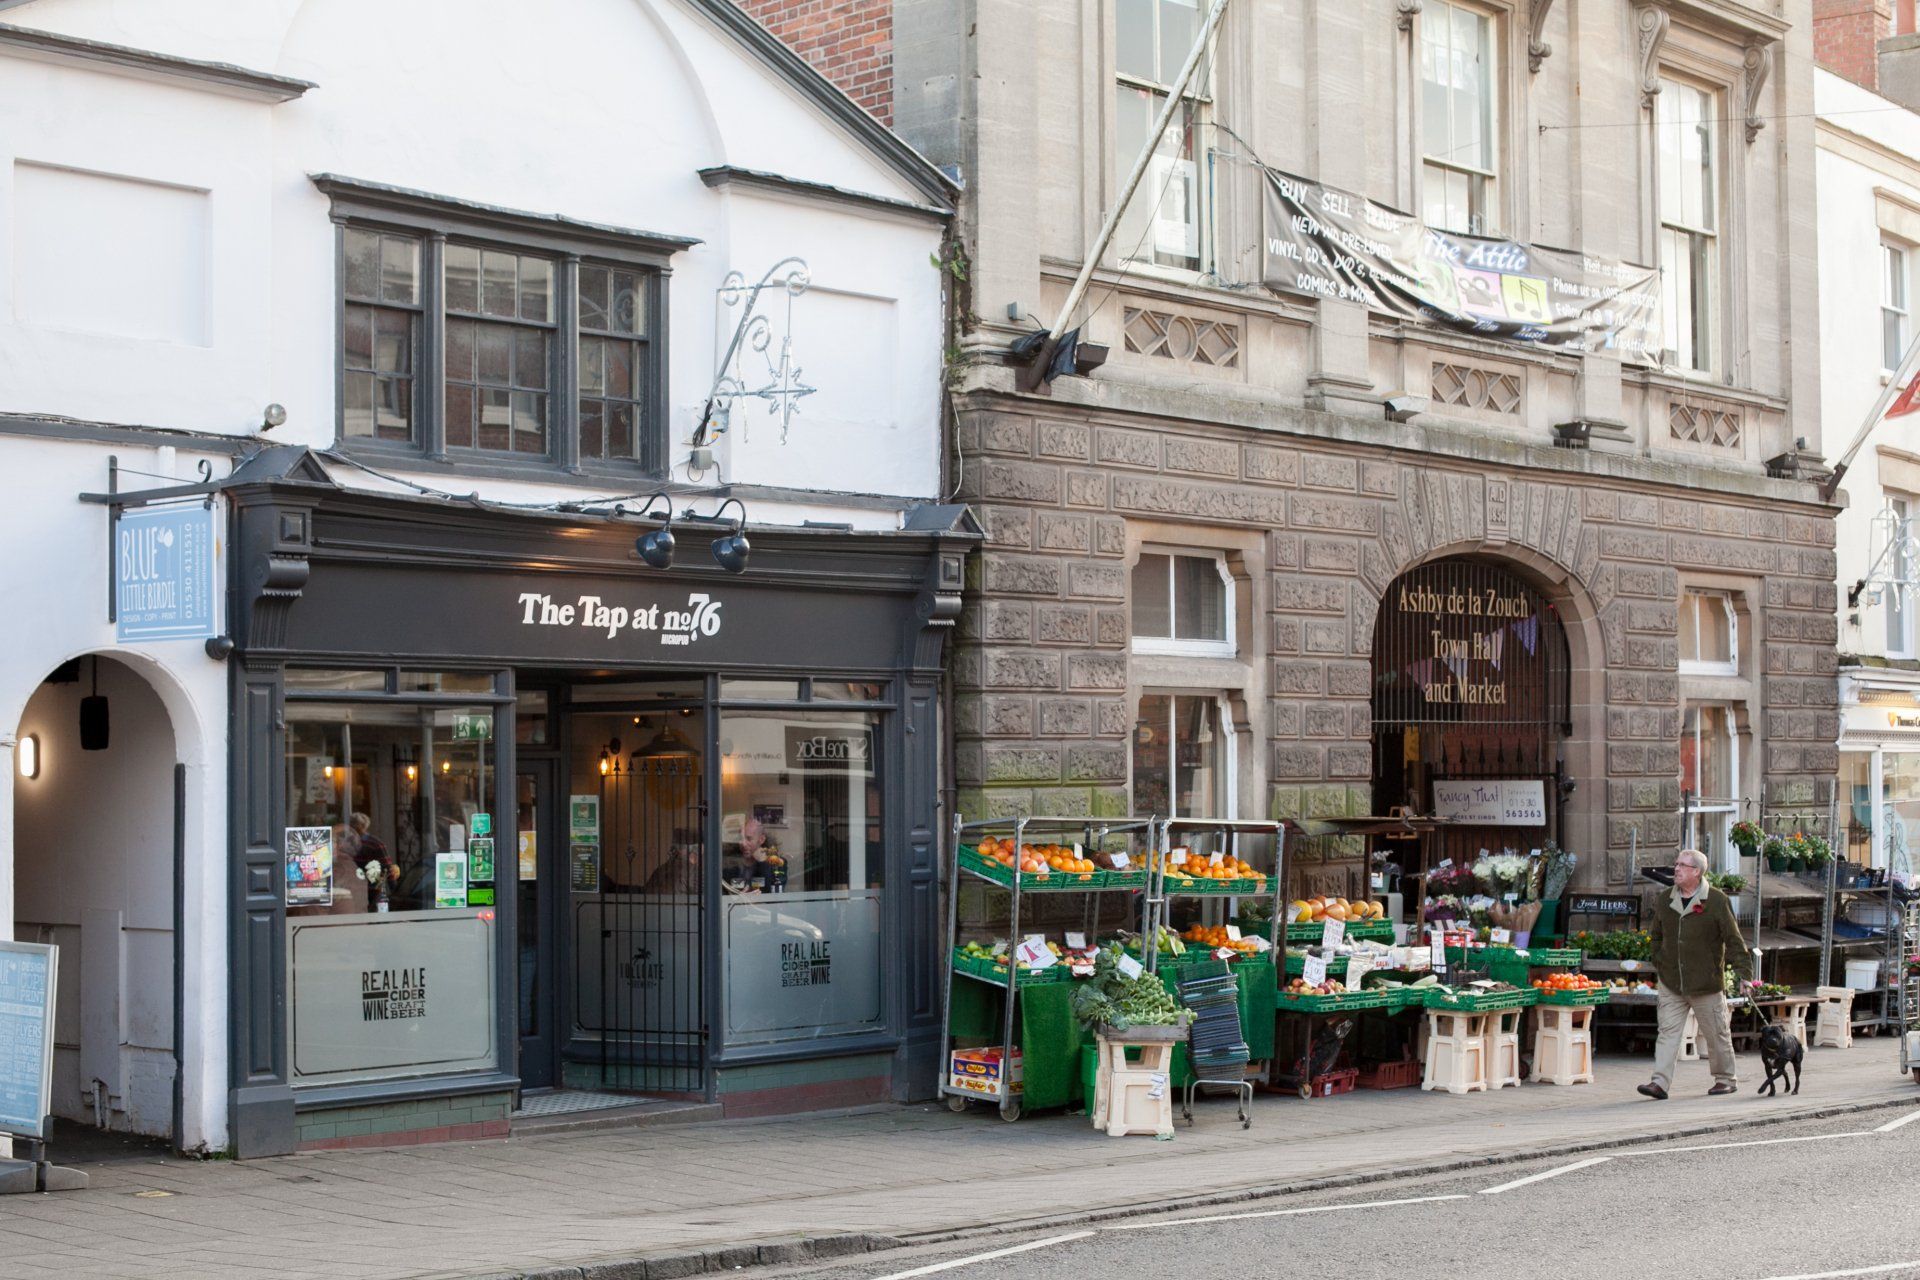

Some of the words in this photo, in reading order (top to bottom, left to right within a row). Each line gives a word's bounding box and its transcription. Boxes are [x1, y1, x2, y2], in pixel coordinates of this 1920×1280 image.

[1279, 178, 1308, 204] BUY
[1322, 192, 1352, 218] SELL
[1292, 214, 1319, 236] NEW
[1342, 231, 1393, 261] PRE-LOVED
[1424, 234, 1460, 260] The
[1465, 244, 1528, 271] Attic
[1297, 273, 1337, 296] COMICS
[1338, 285, 1348, 298] &
[1553, 277, 1578, 295] Phone
[1580, 285, 1590, 297] us
[122, 526, 159, 582] BLUE
[122, 583, 146, 612] LITTLE
[147, 581, 176, 610] BIRDIE
[1400, 584, 1443, 621] Ashby
[1447, 586, 1465, 614] de
[1468, 587, 1482, 616] la
[1486, 588, 1529, 618] Zouch
[518, 592, 576, 626] The
[578, 595, 629, 640] Tap
[631, 603, 658, 630] at
[1431, 630, 1468, 660] Town
[1473, 632, 1502, 661] Hall
[1425, 675, 1451, 703] and
[1457, 676, 1506, 704] Market
[1505, 809, 1542, 818] 563563
[781, 942, 806, 961] REAL
[810, 941, 831, 959] ALE
[21, 961, 45, 973] DESIGN
[781, 960, 810, 971] CIDER
[810, 966, 831, 985] WINE
[362, 969, 399, 992] REAL
[402, 968, 426, 989] ALE
[781, 977, 810, 987] BEER
[20, 990, 44, 1004] PRINT
[389, 988, 425, 1002] CIDER
[389, 1000, 426, 1010] CRAFT
[362, 999, 389, 1021] WINE
[389, 1008, 426, 1019] BEER
[15, 1023, 42, 1039] FLYERS
